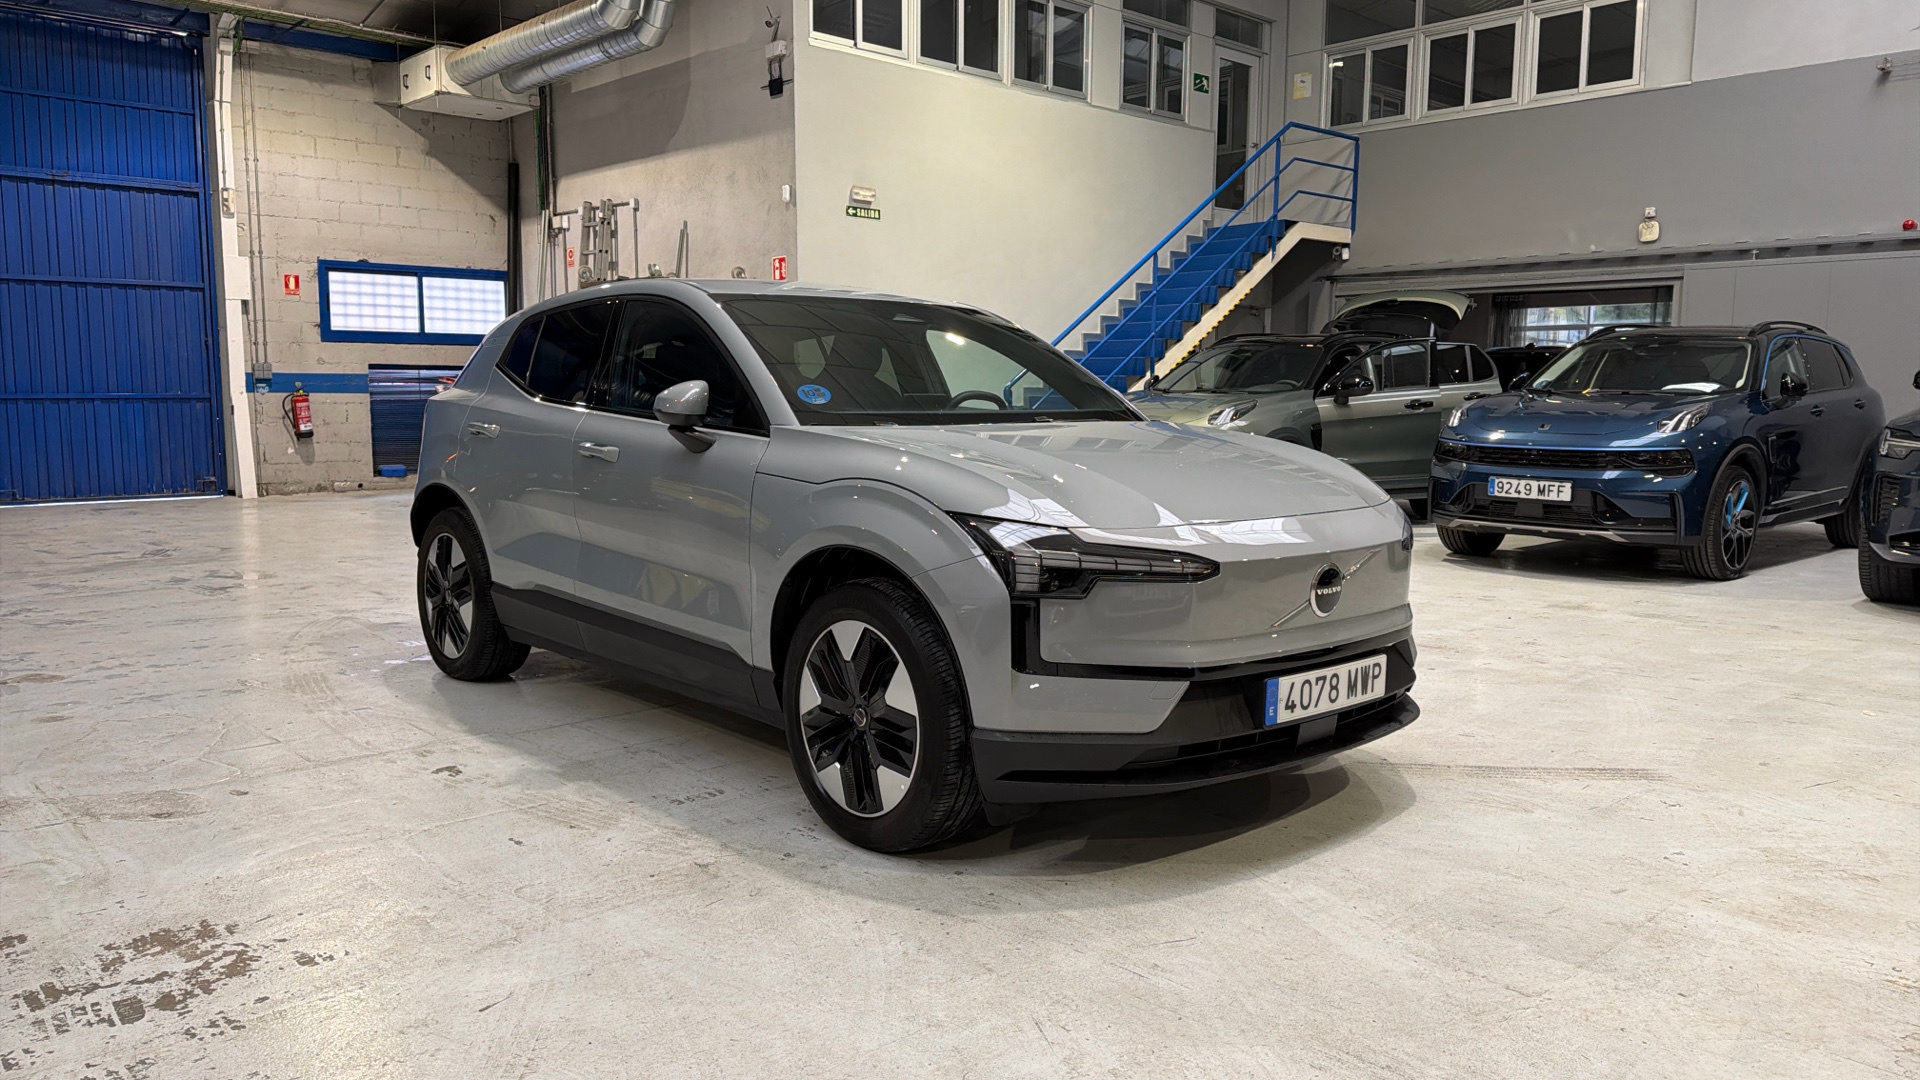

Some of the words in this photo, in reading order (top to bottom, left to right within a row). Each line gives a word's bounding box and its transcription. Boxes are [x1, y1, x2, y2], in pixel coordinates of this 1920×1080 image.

[856, 208, 879, 219] SALIDA
[1496, 480, 1532, 496] 9249
[1537, 483, 1566, 498] MFF
[1316, 585, 1342, 596] VOLVO
[1269, 706, 1275, 716] E
[1284, 672, 1340, 713] 4078
[1347, 662, 1382, 700] MWP
